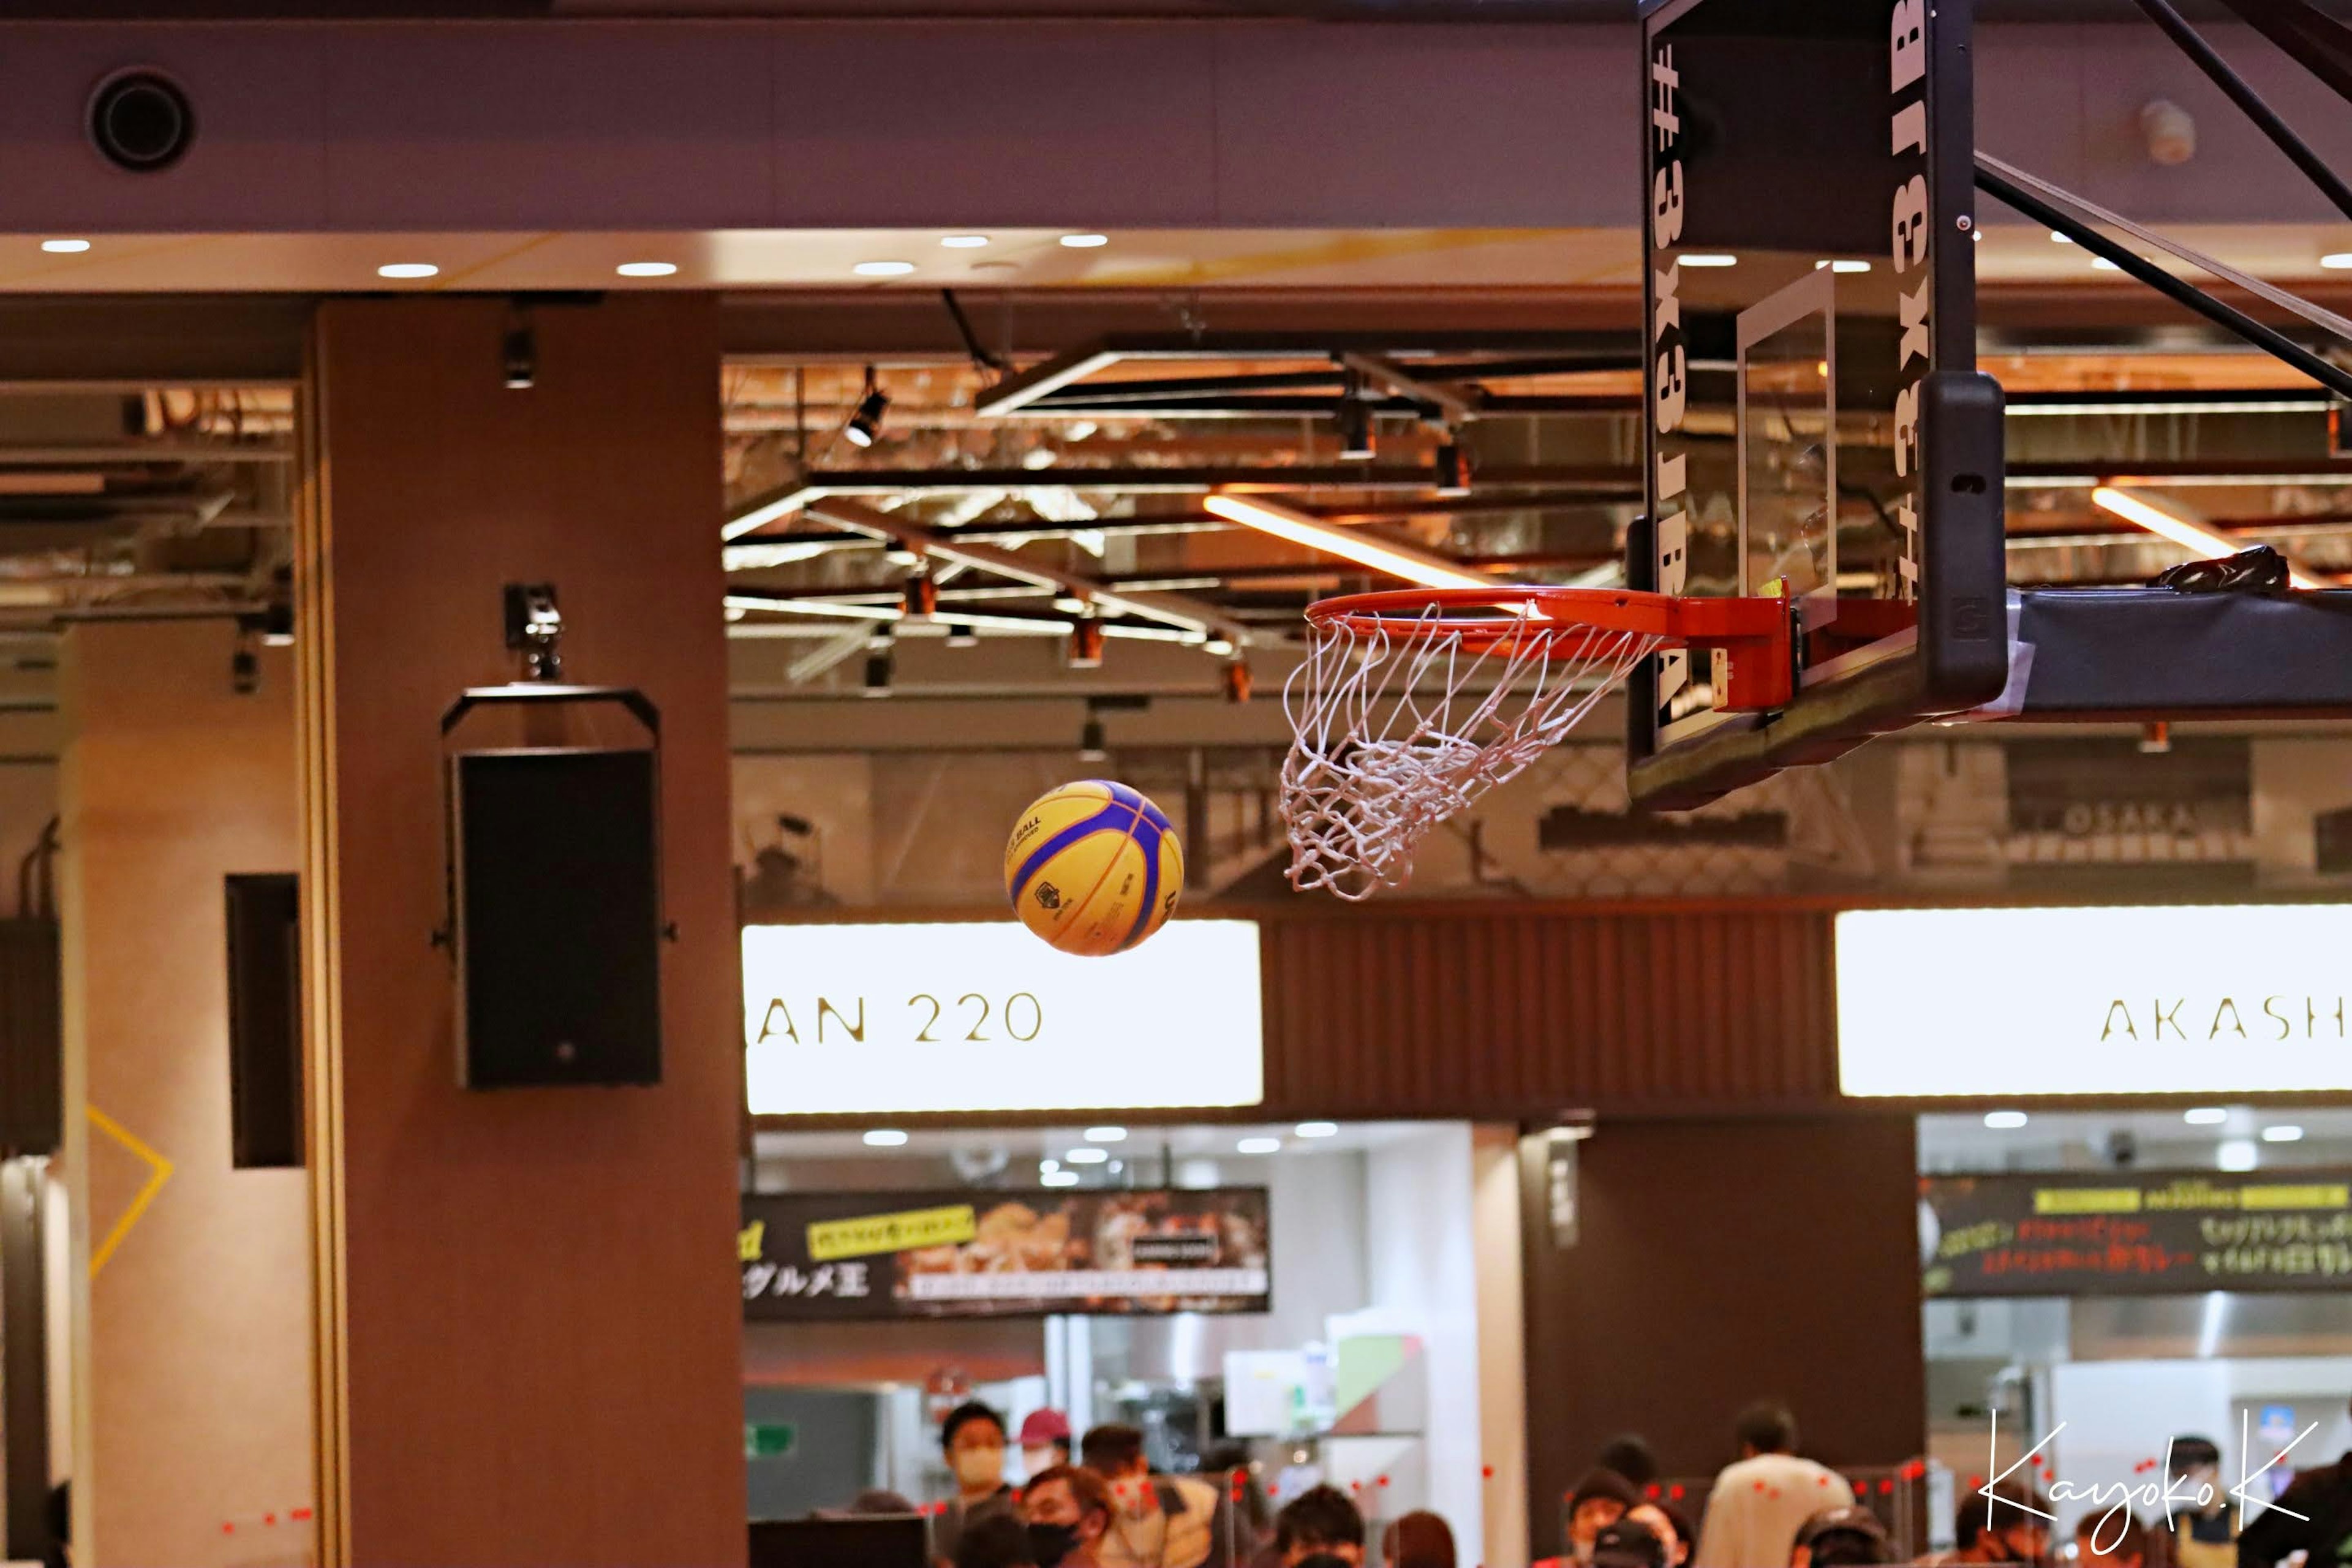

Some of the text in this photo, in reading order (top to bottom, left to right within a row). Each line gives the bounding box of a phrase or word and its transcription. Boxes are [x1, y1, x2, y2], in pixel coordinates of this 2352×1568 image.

[1017, 816, 1041, 840] BALL
[2065, 802, 2194, 834] OSAKA
[757, 992, 1042, 1044] AN 220
[2100, 995, 2343, 1041] AKASH
